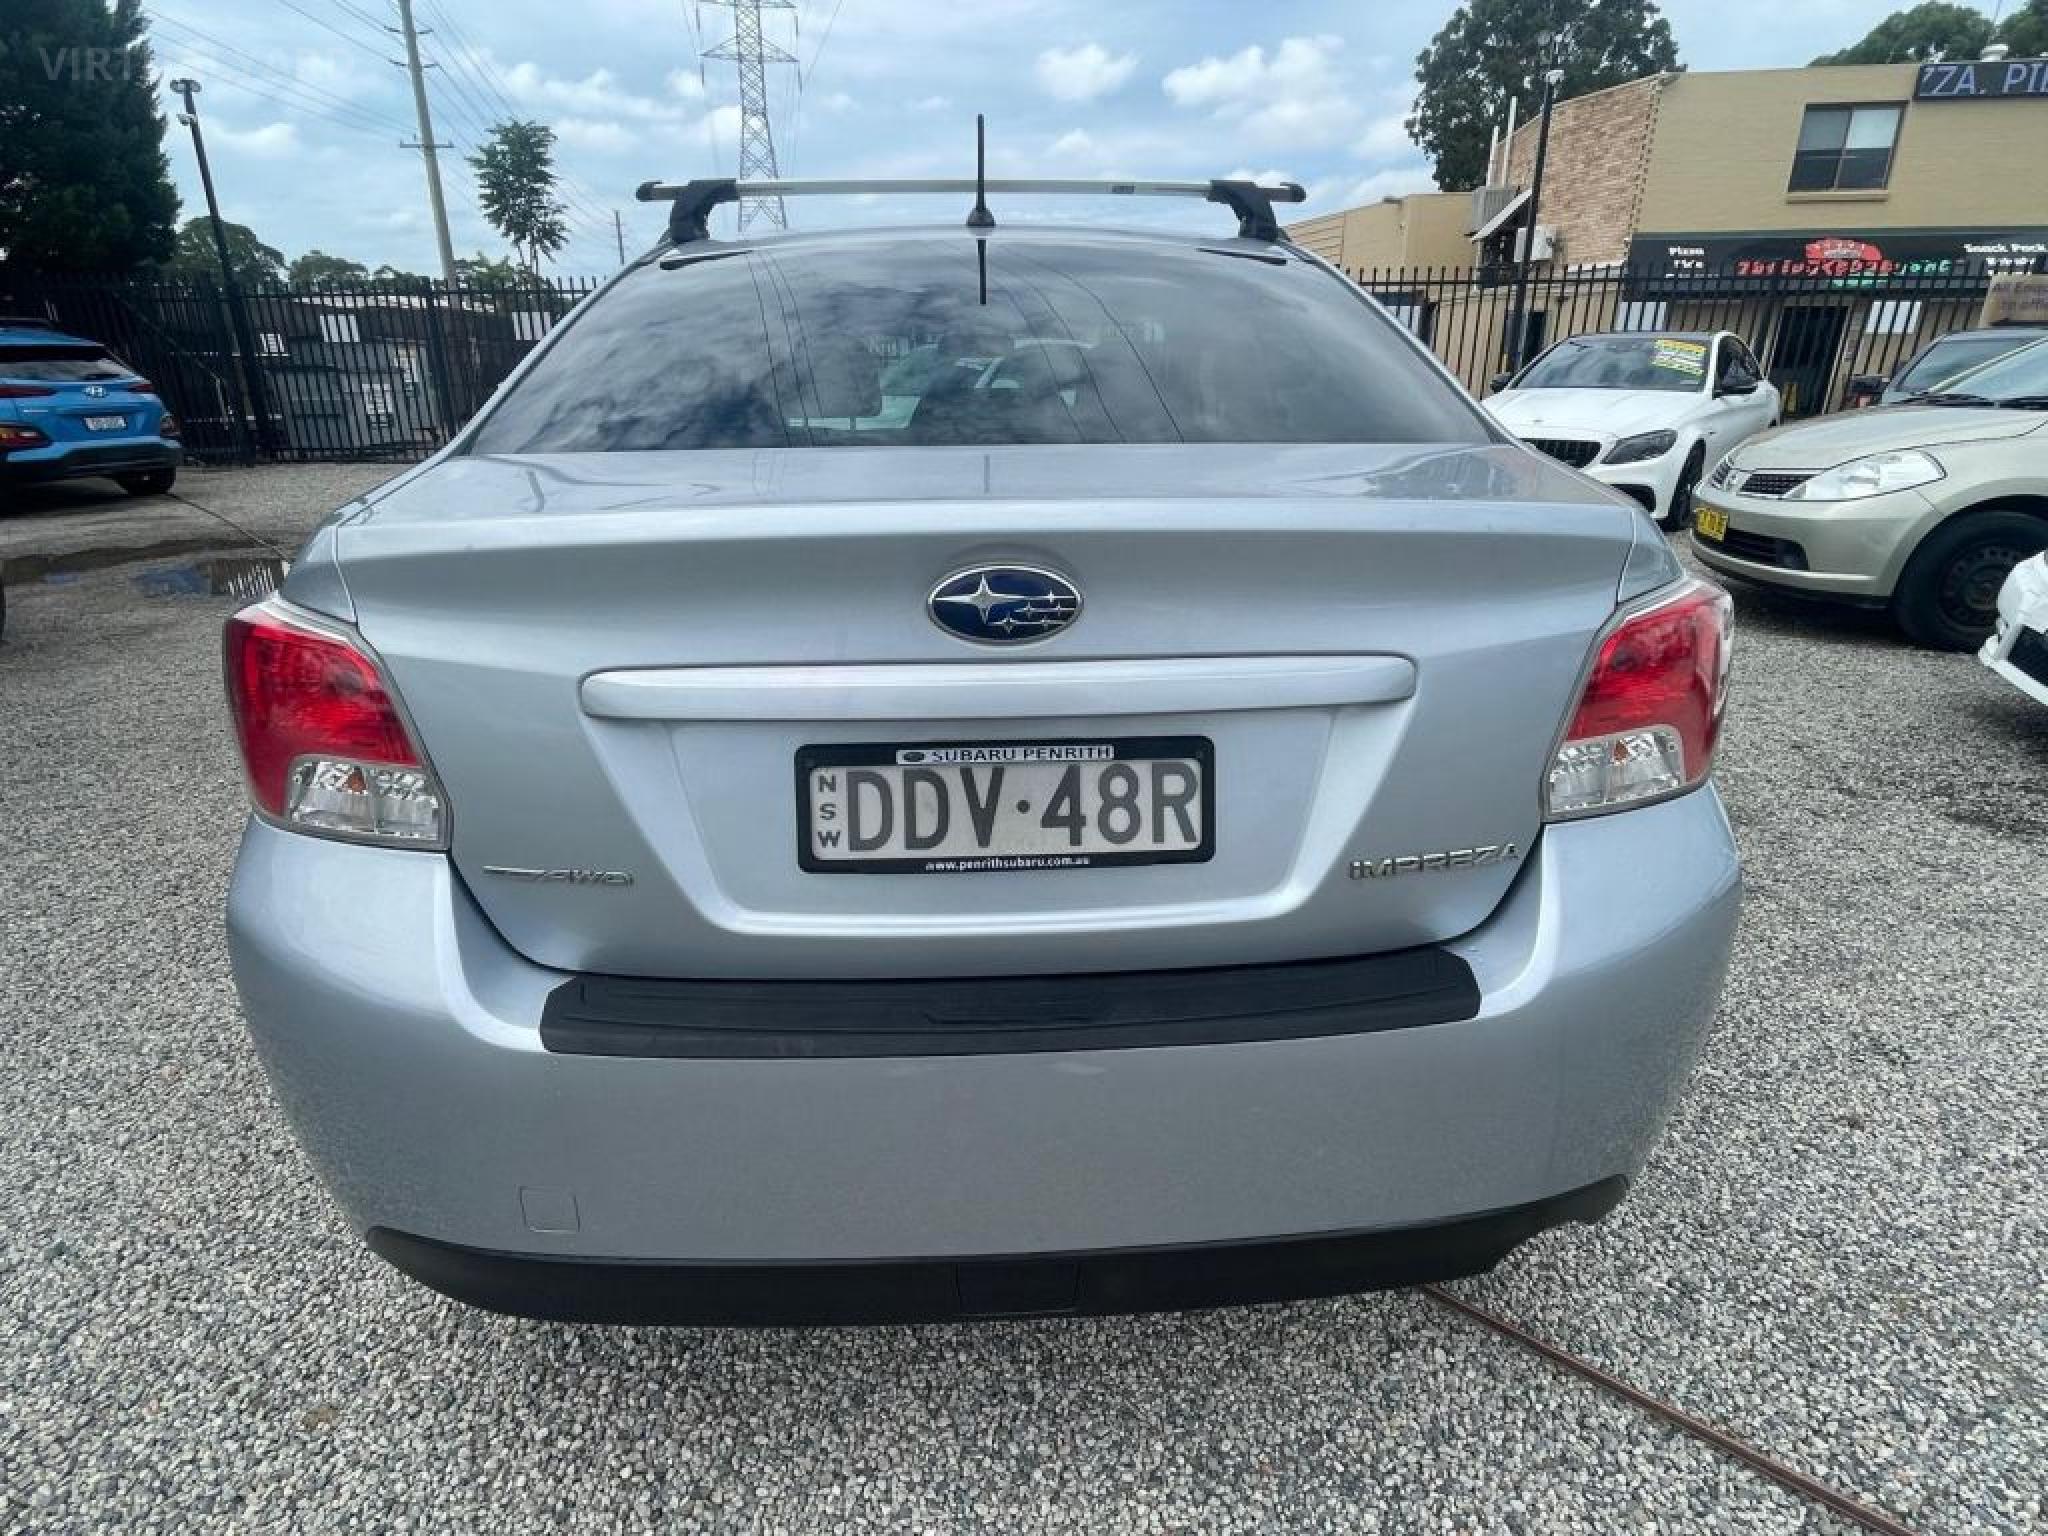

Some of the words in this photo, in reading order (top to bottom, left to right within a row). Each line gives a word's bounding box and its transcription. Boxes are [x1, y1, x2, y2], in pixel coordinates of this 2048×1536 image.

[930, 748, 1017, 764] SUBARU
[1023, 745, 1113, 761] PENRITH
[925, 856, 1091, 872] www.penrithsubaru.com.au
[1350, 842, 1519, 881] IMPREZA
